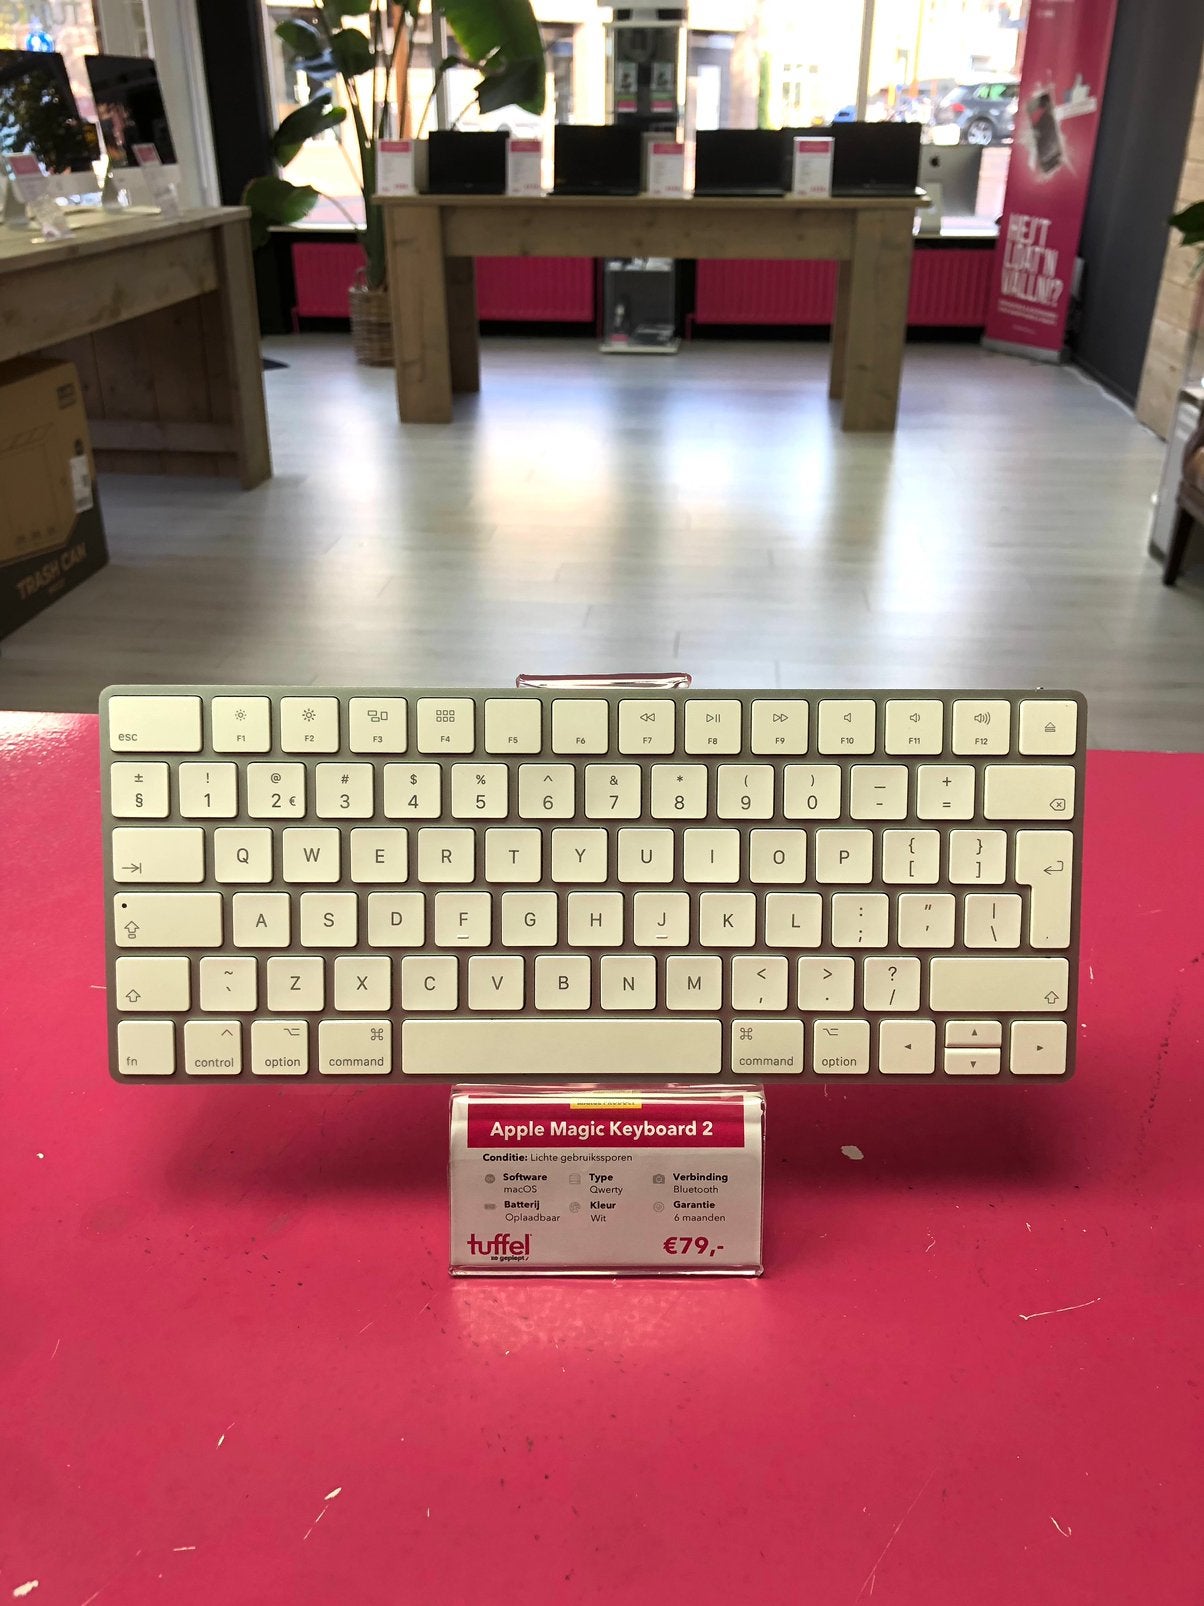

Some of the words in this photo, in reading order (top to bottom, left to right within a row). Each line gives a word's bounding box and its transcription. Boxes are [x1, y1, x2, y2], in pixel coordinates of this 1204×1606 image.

[118, 733, 138, 742] esc
[236, 734, 246, 742] F1
[304, 734, 315, 742] F2
[372, 735, 383, 744] F3
[440, 735, 451, 743] F4
[508, 736, 519, 744] F5
[575, 737, 586, 745] F6
[642, 736, 653, 744] F7
[707, 737, 718, 745] F8
[775, 737, 786, 745] F9
[840, 736, 855, 745] F10
[908, 737, 921, 745] F11
[974, 737, 988, 745] F12
[270, 772, 282, 784] @
[340, 774, 350, 784] #
[410, 773, 418, 786] $
[475, 774, 487, 785] %
[609, 775, 619, 786] &
[942, 776, 952, 787] +
[135, 792, 144, 808] §
[204, 792, 211, 808] 1
[271, 793, 282, 808] 2
[288, 795, 297, 807] €
[339, 793, 350, 809] 3
[407, 794, 419, 809] 4
[475, 794, 486, 810] 5
[542, 795, 554, 810] 6
[609, 795, 619, 810] 7
[674, 795, 685, 810] 8
[740, 795, 751, 811] 9
[807, 794, 818, 810] 0
[908, 837, 916, 855] {
[976, 838, 983, 856] }
[236, 847, 249, 865] Q
[303, 847, 321, 863] W
[375, 848, 385, 864] E
[441, 848, 452, 864] R
[508, 849, 520, 864] T
[574, 848, 586, 863] Y
[640, 849, 653, 864] U
[773, 849, 786, 865] O
[839, 850, 850, 865] P
[909, 860, 915, 878] [
[975, 861, 982, 879] ]
[255, 913, 268, 928] A
[323, 912, 335, 928] S
[391, 911, 403, 926] D
[459, 912, 469, 927] F
[524, 911, 536, 927] G
[590, 912, 602, 928] H
[657, 911, 666, 927] J
[723, 913, 734, 928] K
[791, 913, 801, 929] L
[756, 968, 767, 980] <
[823, 968, 833, 980] >
[888, 966, 898, 982] ?
[290, 975, 301, 991] Z
[356, 975, 368, 991] X
[424, 975, 436, 991] C
[491, 975, 504, 991] V
[558, 975, 570, 990] B
[623, 976, 635, 991] N
[687, 975, 702, 991] M
[889, 988, 896, 1006] /
[126, 1056, 138, 1066] fn
[194, 1057, 234, 1068] control
[264, 1056, 301, 1069] option
[328, 1056, 384, 1067] command
[739, 1056, 794, 1067] command
[821, 1056, 857, 1068] option
[489, 1120, 545, 1141] Apple
[550, 1120, 605, 1141] Magic
[609, 1120, 697, 1141] Keyboard
[702, 1120, 713, 1136] 2
[482, 1152, 528, 1162] Conditie:
[530, 1152, 559, 1162] Lichte
[560, 1152, 633, 1164] gebruikssporen
[502, 1172, 548, 1181] Software
[588, 1172, 614, 1184] Type
[672, 1172, 729, 1184] Verbinding
[503, 1184, 538, 1194] macOS
[589, 1185, 624, 1196] Qwerty
[673, 1184, 719, 1194] Bluetooth
[504, 1199, 540, 1211] Batterij
[590, 1200, 617, 1210] Kleur
[673, 1200, 716, 1209] Garantie
[504, 1212, 561, 1224] Oplaadbaar
[590, 1214, 606, 1223] Wit
[673, 1213, 680, 1222] 6
[682, 1213, 726, 1222] maanden
[466, 1233, 530, 1256] tuffel
[662, 1236, 724, 1257] €79,-
